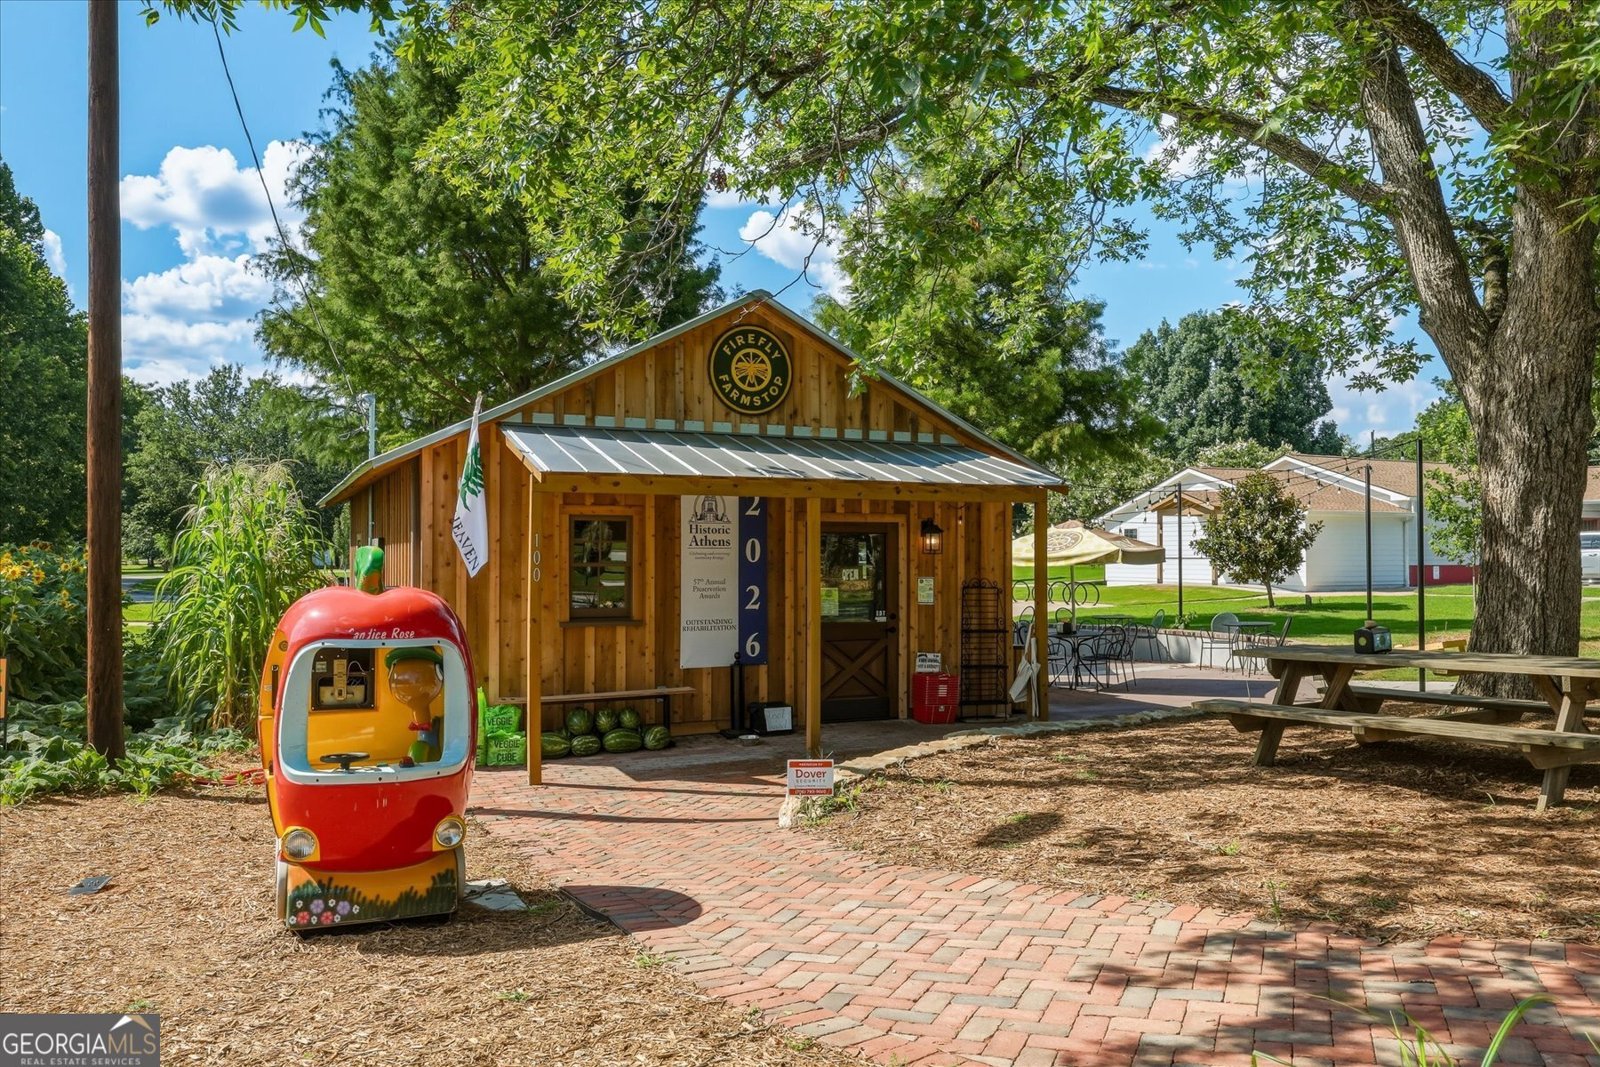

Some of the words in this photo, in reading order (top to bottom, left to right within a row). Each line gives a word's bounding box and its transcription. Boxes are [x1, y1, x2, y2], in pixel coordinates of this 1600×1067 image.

[723, 334, 781, 359] FIREFLY
[719, 374, 783, 406] FARMSTOP
[689, 524, 731, 534] Historic
[689, 535, 731, 546] Athens
[533, 533, 541, 582] 100
[391, 627, 415, 639] Rose
[486, 716, 513, 726] VEGGIE
[494, 739, 521, 748] VEGGIE
[496, 752, 517, 762] CUBE
[795, 769, 827, 778] Dover
